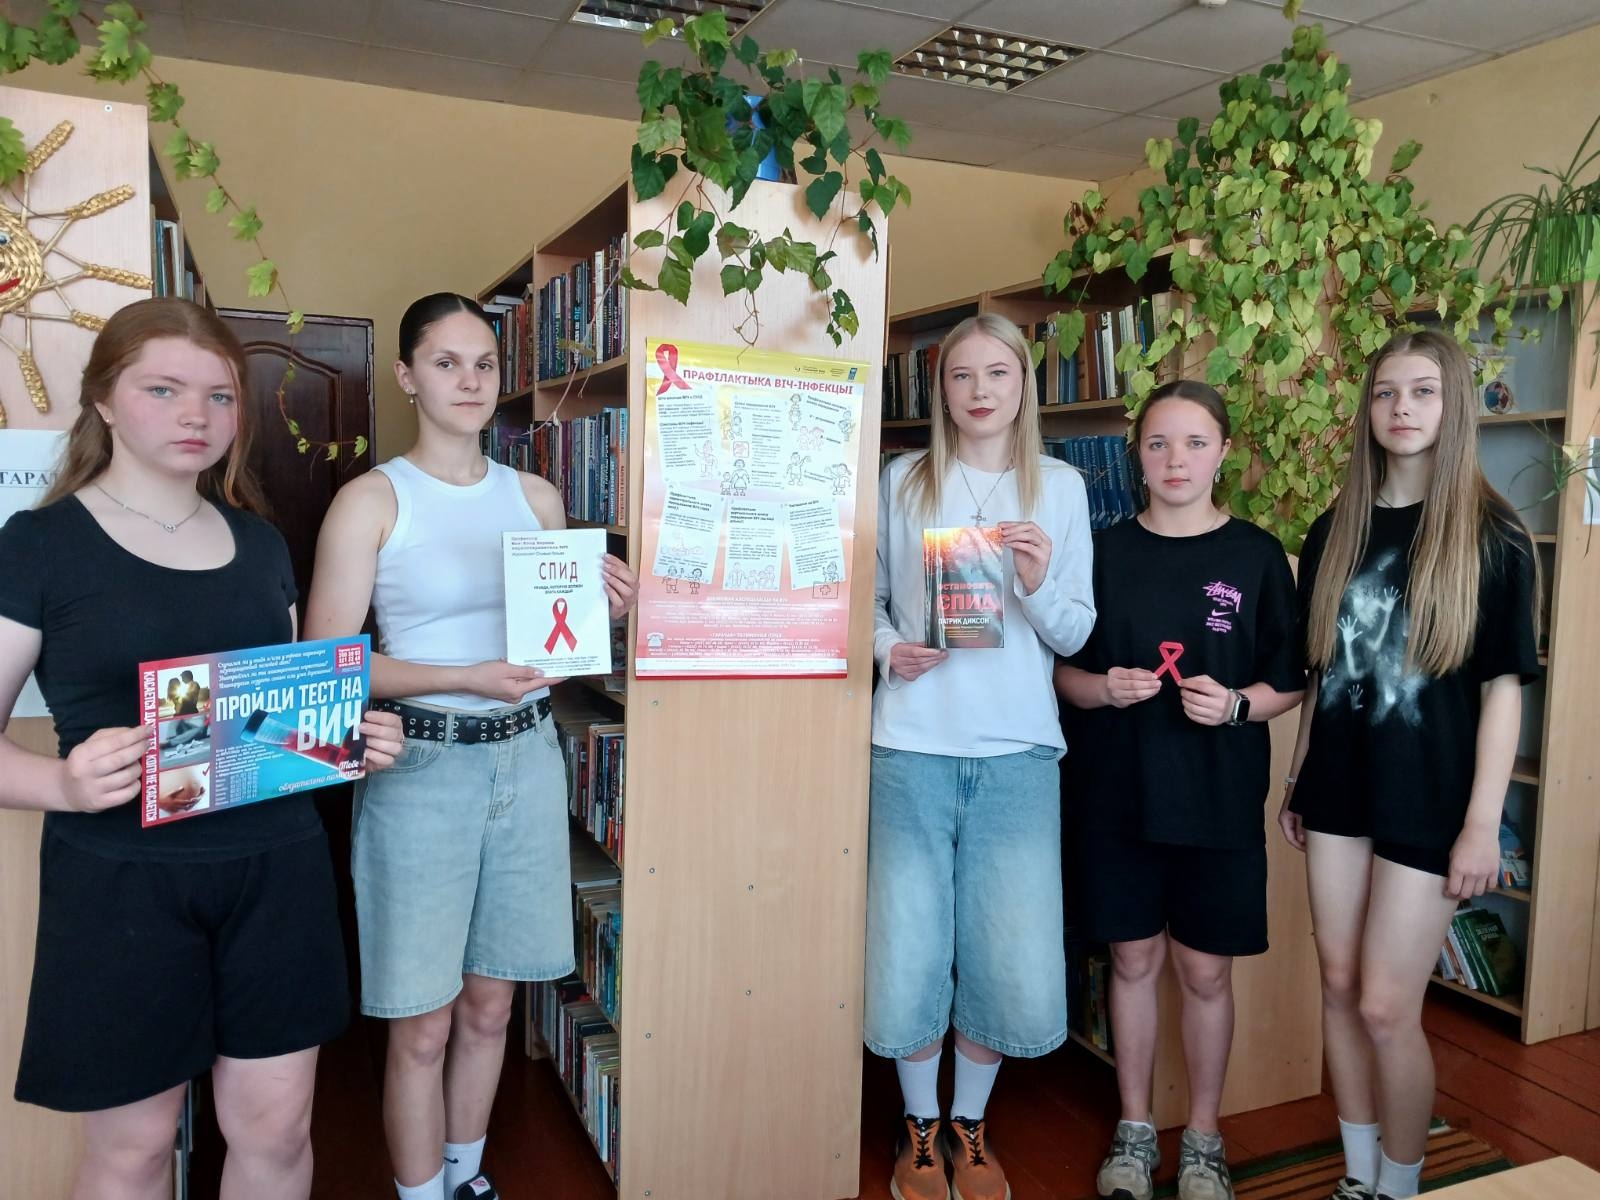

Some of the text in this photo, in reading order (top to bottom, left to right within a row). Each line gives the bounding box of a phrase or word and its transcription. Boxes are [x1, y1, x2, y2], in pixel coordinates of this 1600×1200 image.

[683, 369, 854, 395] ПРАФІЛАКТЫКА ВІЧ-ІНФЕКЦЫІ
[539, 561, 578, 582] СПИД
[937, 593, 998, 612] СПИД
[938, 617, 991, 626] ПАТРИК ДИКСОН
[143, 671, 156, 710] КАСАЕТСЯ
[215, 676, 363, 722] ПРОЙДИ ТЕСТ НА
[297, 699, 363, 752] ВИЧ
[145, 755, 157, 774] КОГО
[146, 774, 157, 785] НЕ
[278, 777, 325, 792] обязательно
[146, 785, 157, 822] КАСАЕТСЯ
